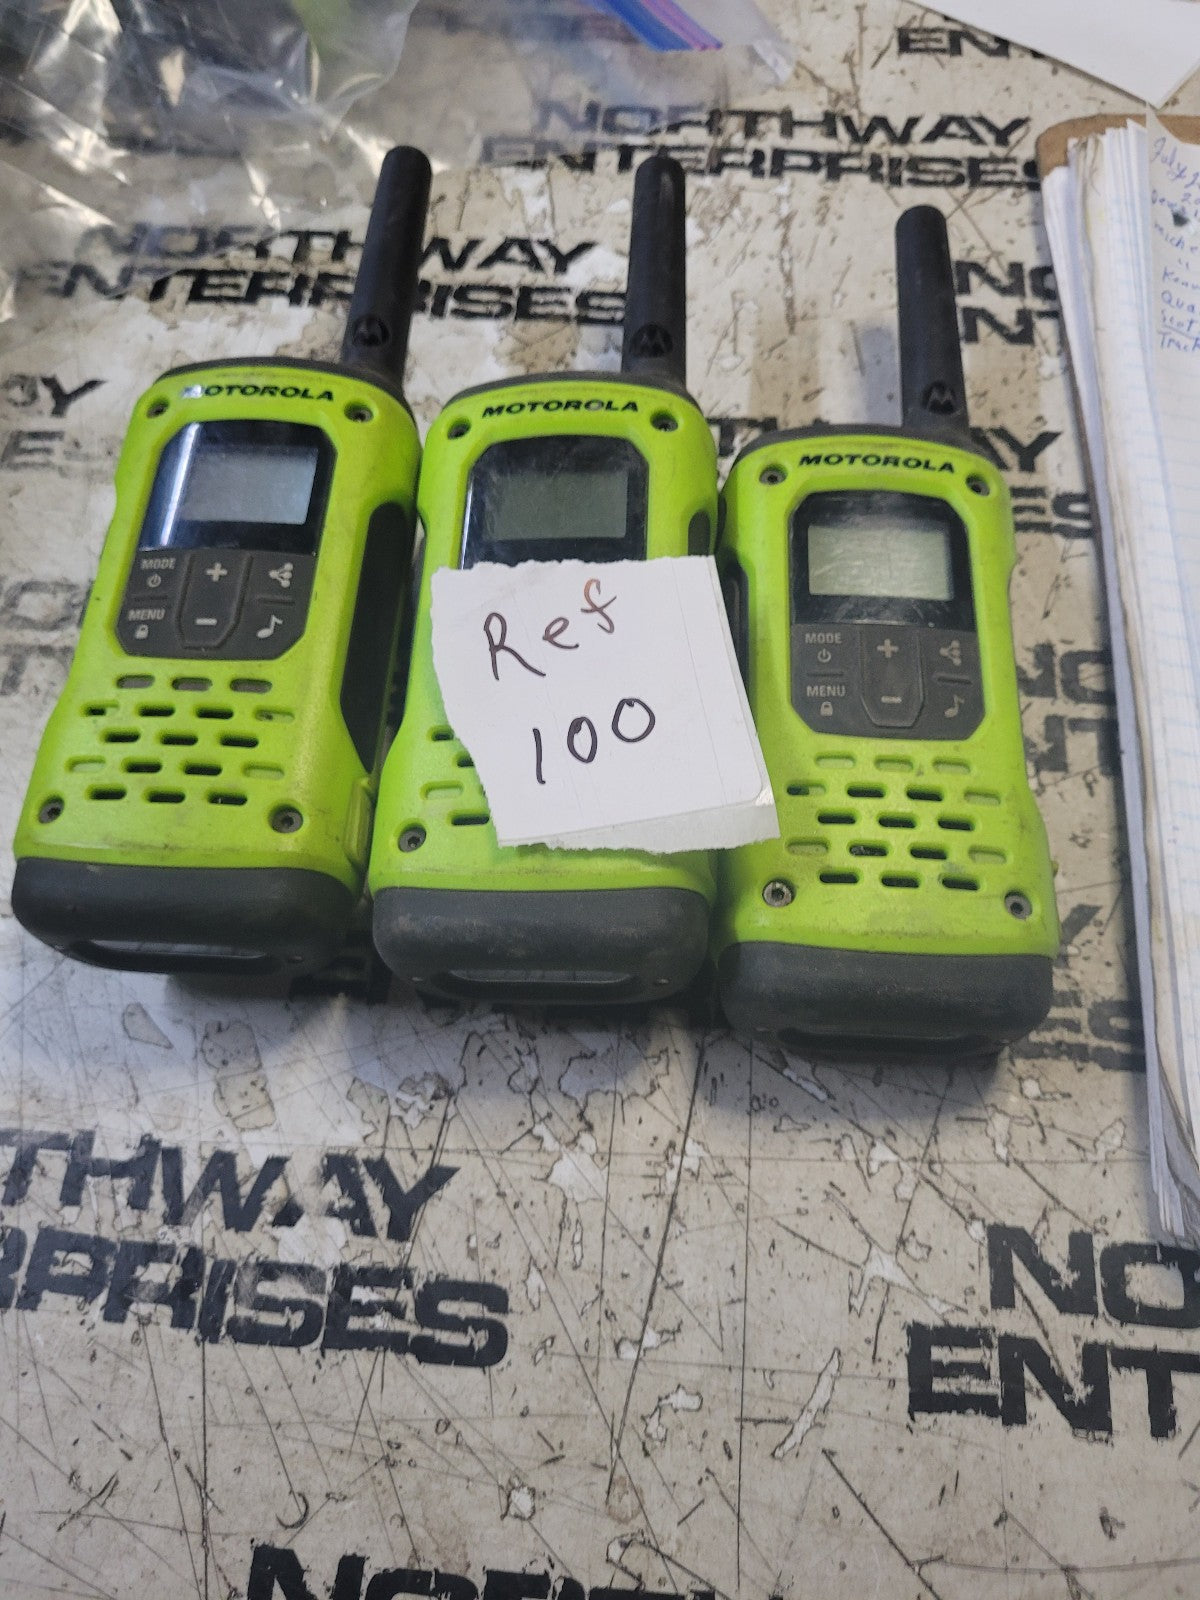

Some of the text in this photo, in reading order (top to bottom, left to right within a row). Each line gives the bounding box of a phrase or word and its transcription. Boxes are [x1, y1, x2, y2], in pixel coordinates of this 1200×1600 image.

[534, 99, 1030, 147] NORTHWAY
[181, 383, 334, 401] MOTOROLA
[482, 399, 639, 418] MOTOROLA
[798, 453, 956, 475] MOTOROLA
[141, 557, 176, 570] MODE
[128, 608, 166, 621] MENU
[483, 578, 617, 681] Ref
[804, 632, 843, 644] MODE
[806, 685, 847, 697] MENU
[532, 697, 656, 785] 100
[986, 1221, 1200, 1329] NO
[906, 1321, 1200, 1441] ENT
